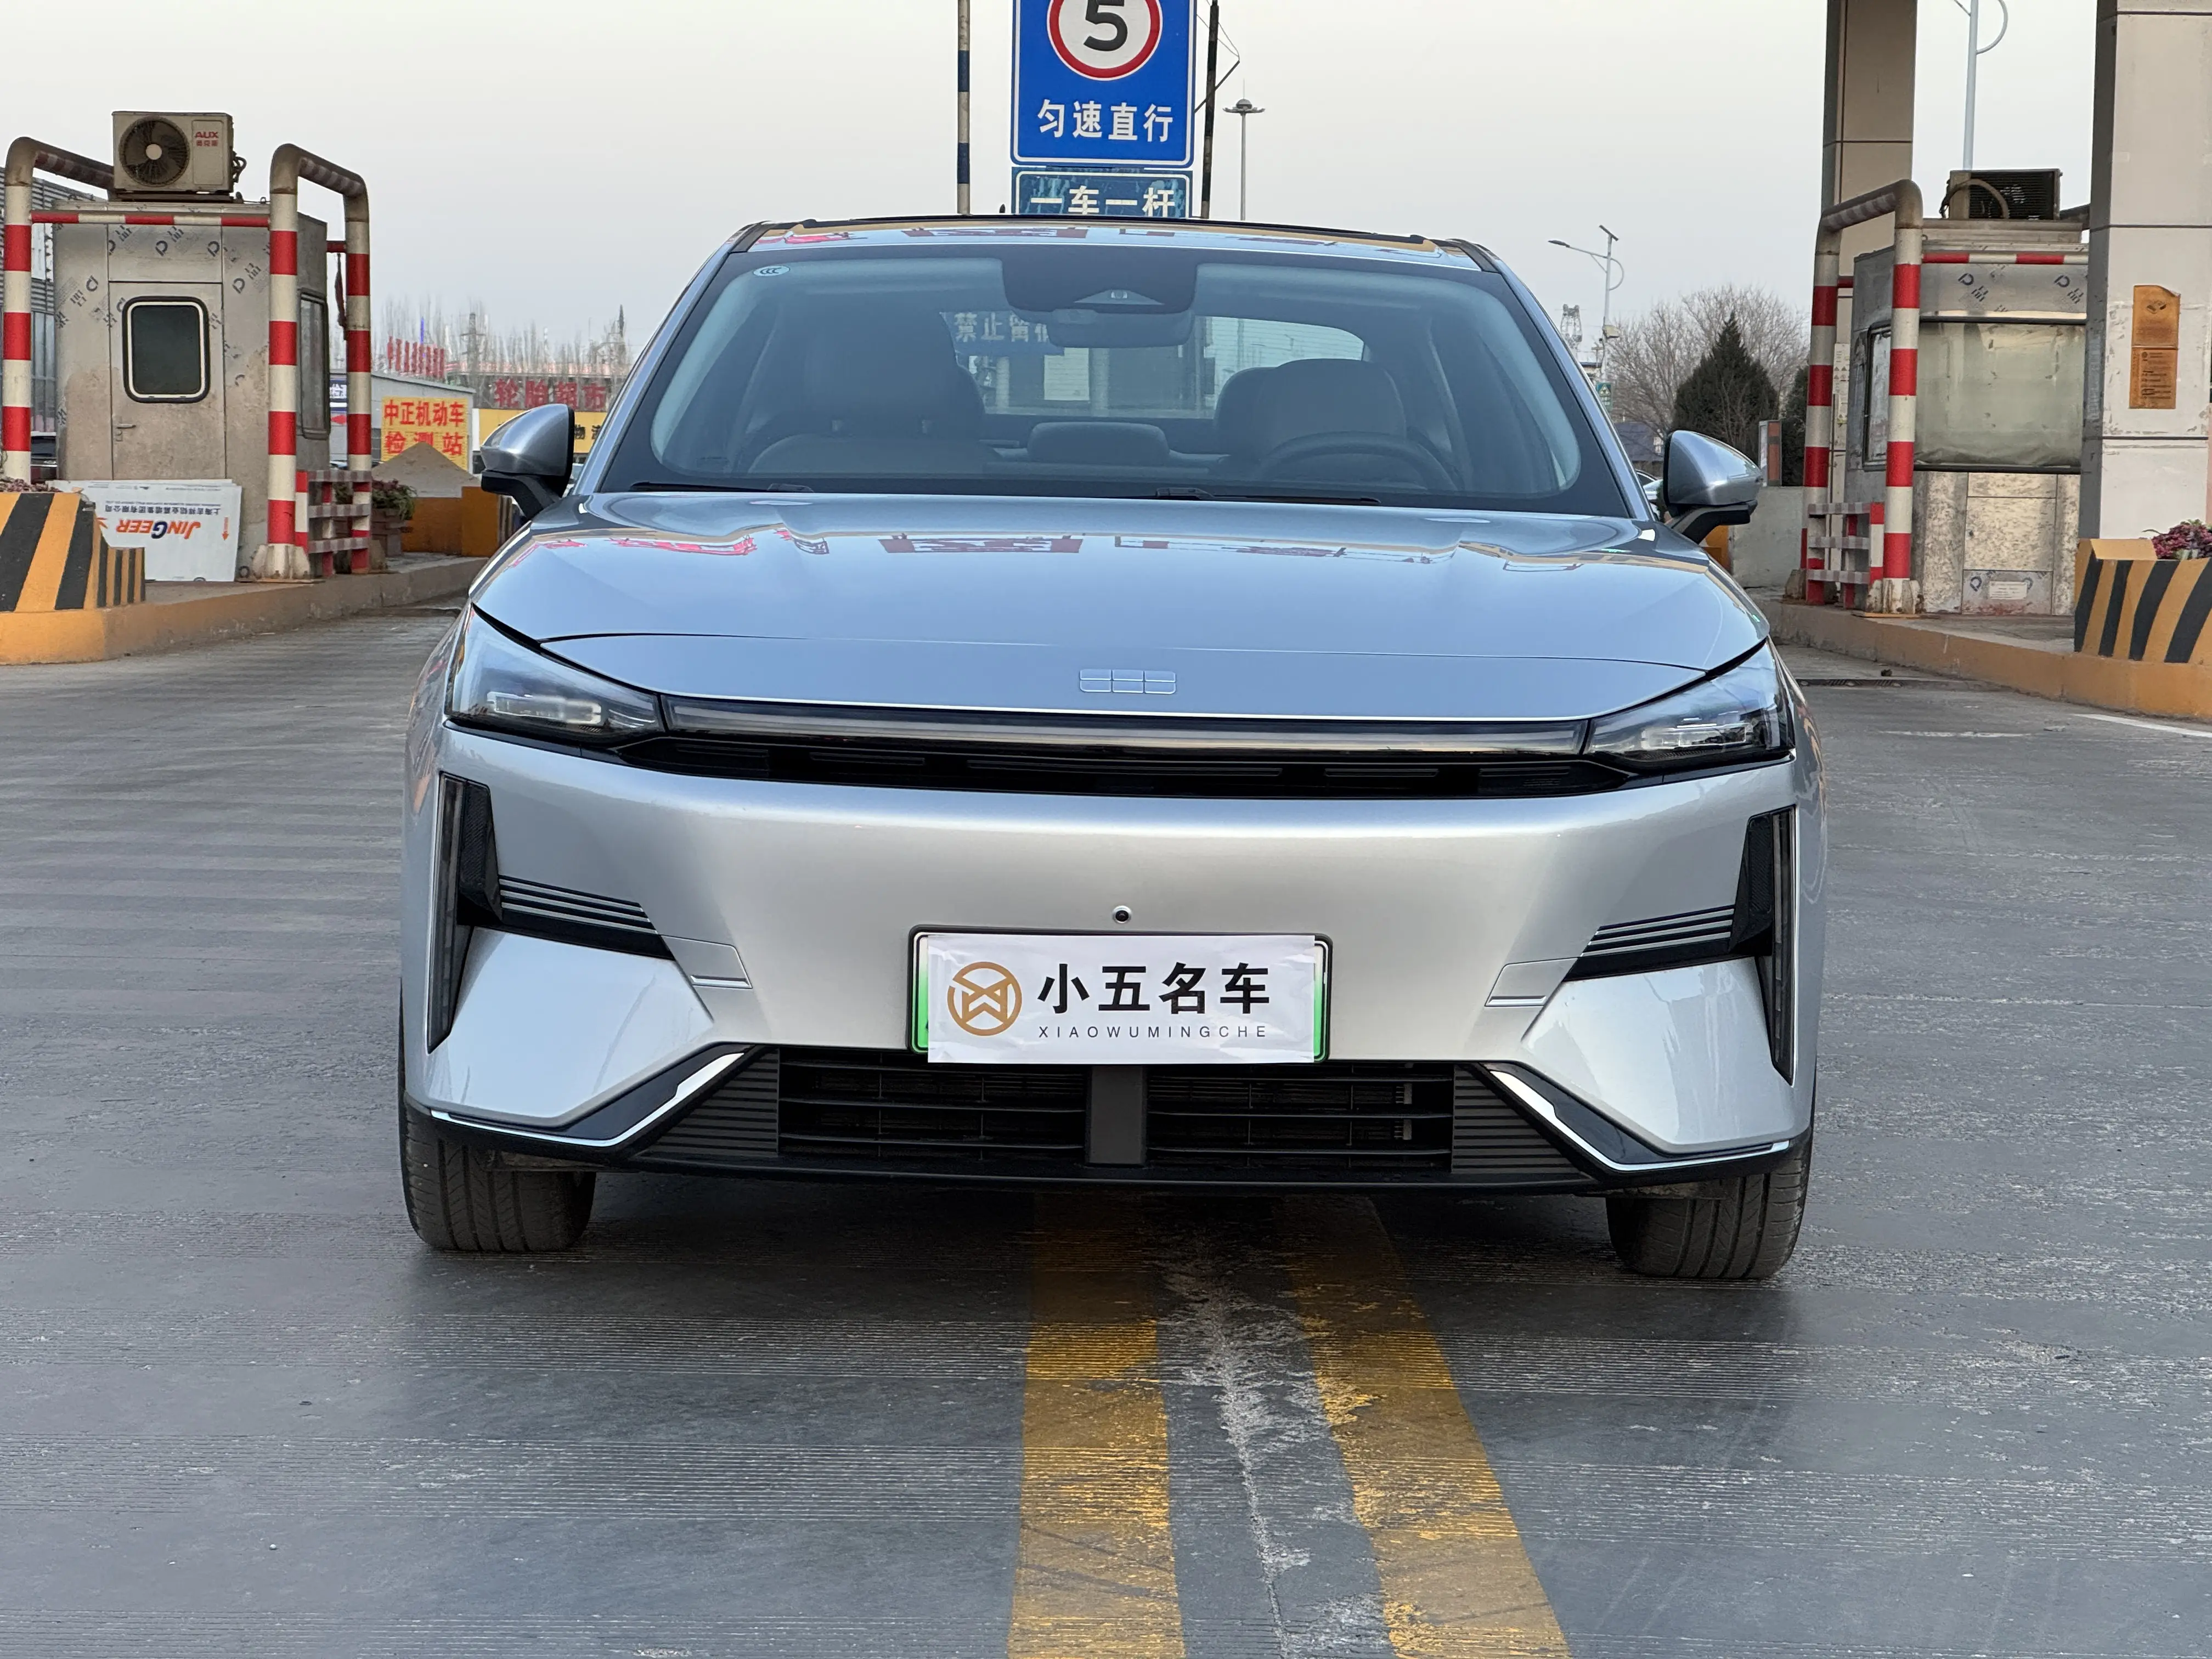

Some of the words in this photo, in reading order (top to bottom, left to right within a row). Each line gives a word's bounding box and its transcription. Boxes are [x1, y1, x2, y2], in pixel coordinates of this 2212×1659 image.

[1084, 0, 1128, 52] 5
[1037, 99, 1174, 143] 匀速直行
[1030, 185, 1176, 217] 一车一杆
[384, 399, 465, 427] 中正机动车
[1037, 962, 1270, 1015] 小五名车
[1039, 1025, 1266, 1038] XIAOWUMINGCHE
